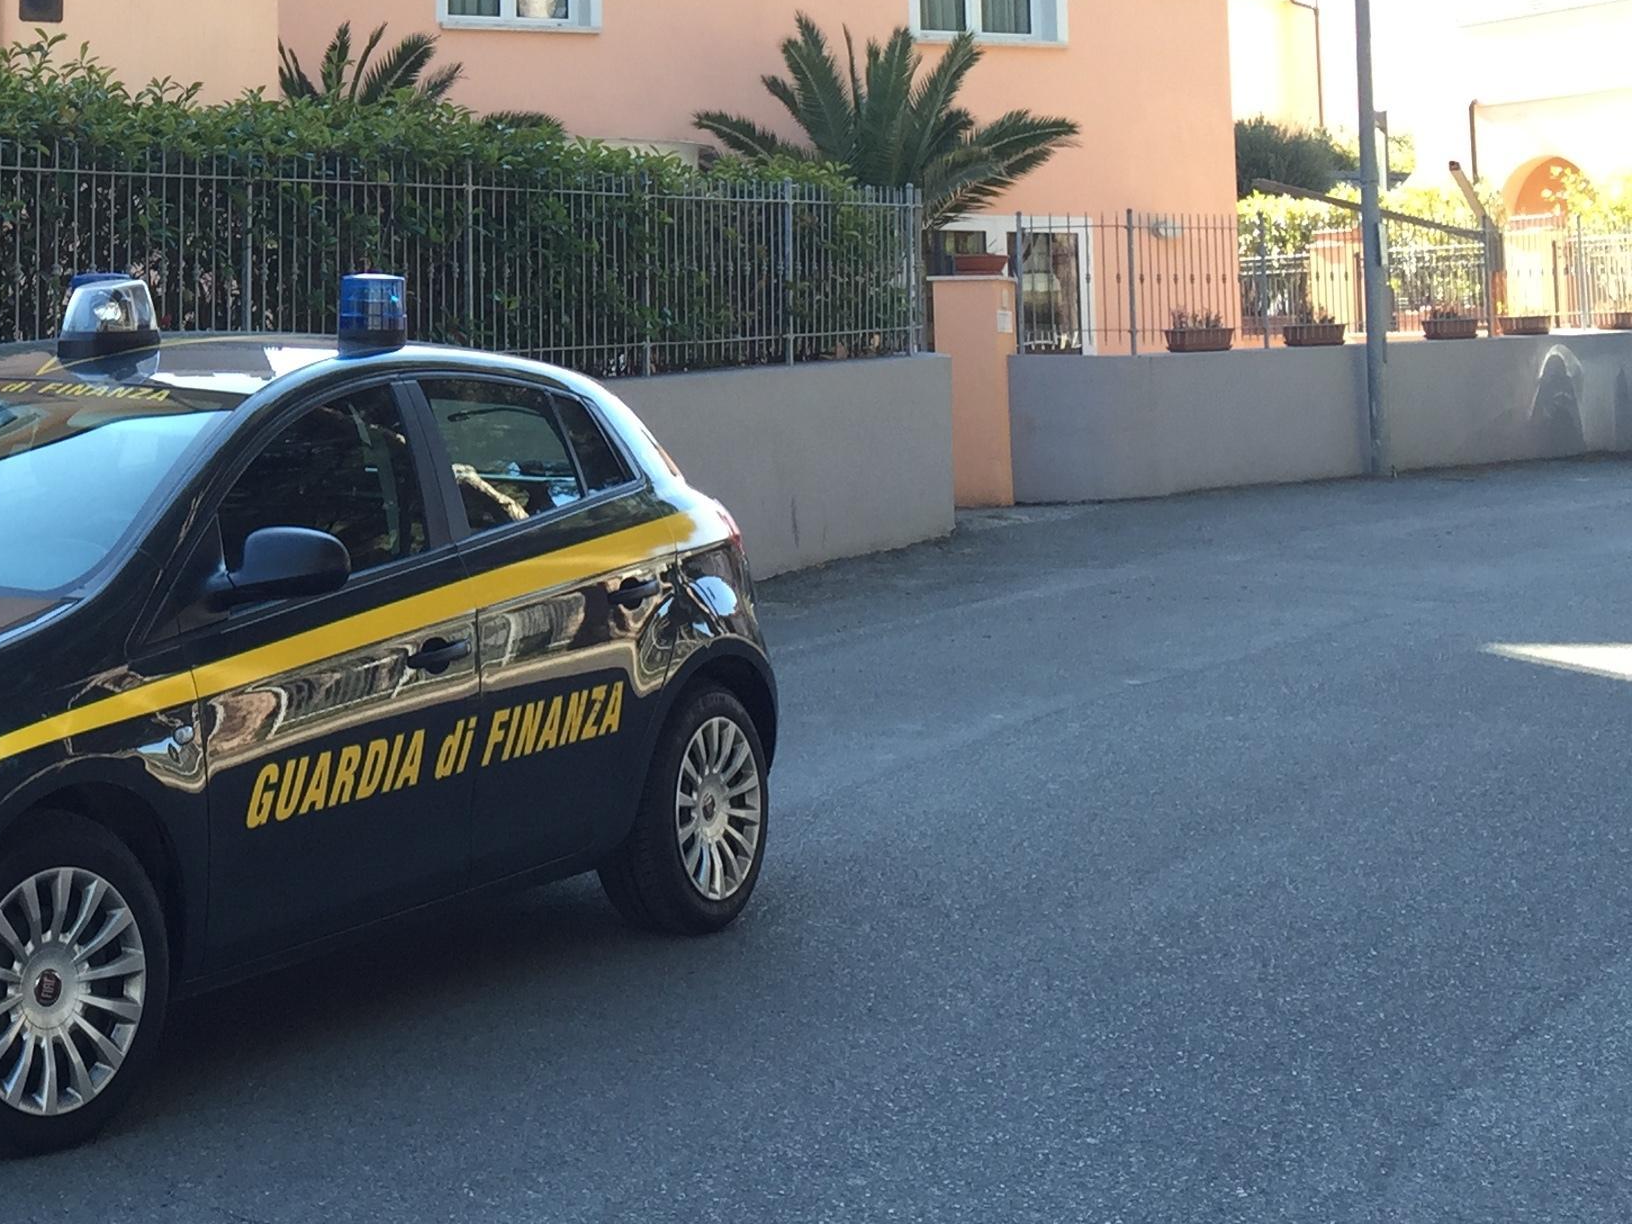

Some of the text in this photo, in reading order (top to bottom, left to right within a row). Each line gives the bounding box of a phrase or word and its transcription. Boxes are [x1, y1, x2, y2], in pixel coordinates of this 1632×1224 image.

[38, 382, 171, 402] FINANZA
[246, 680, 624, 829] GUARDIA di FINANZA
